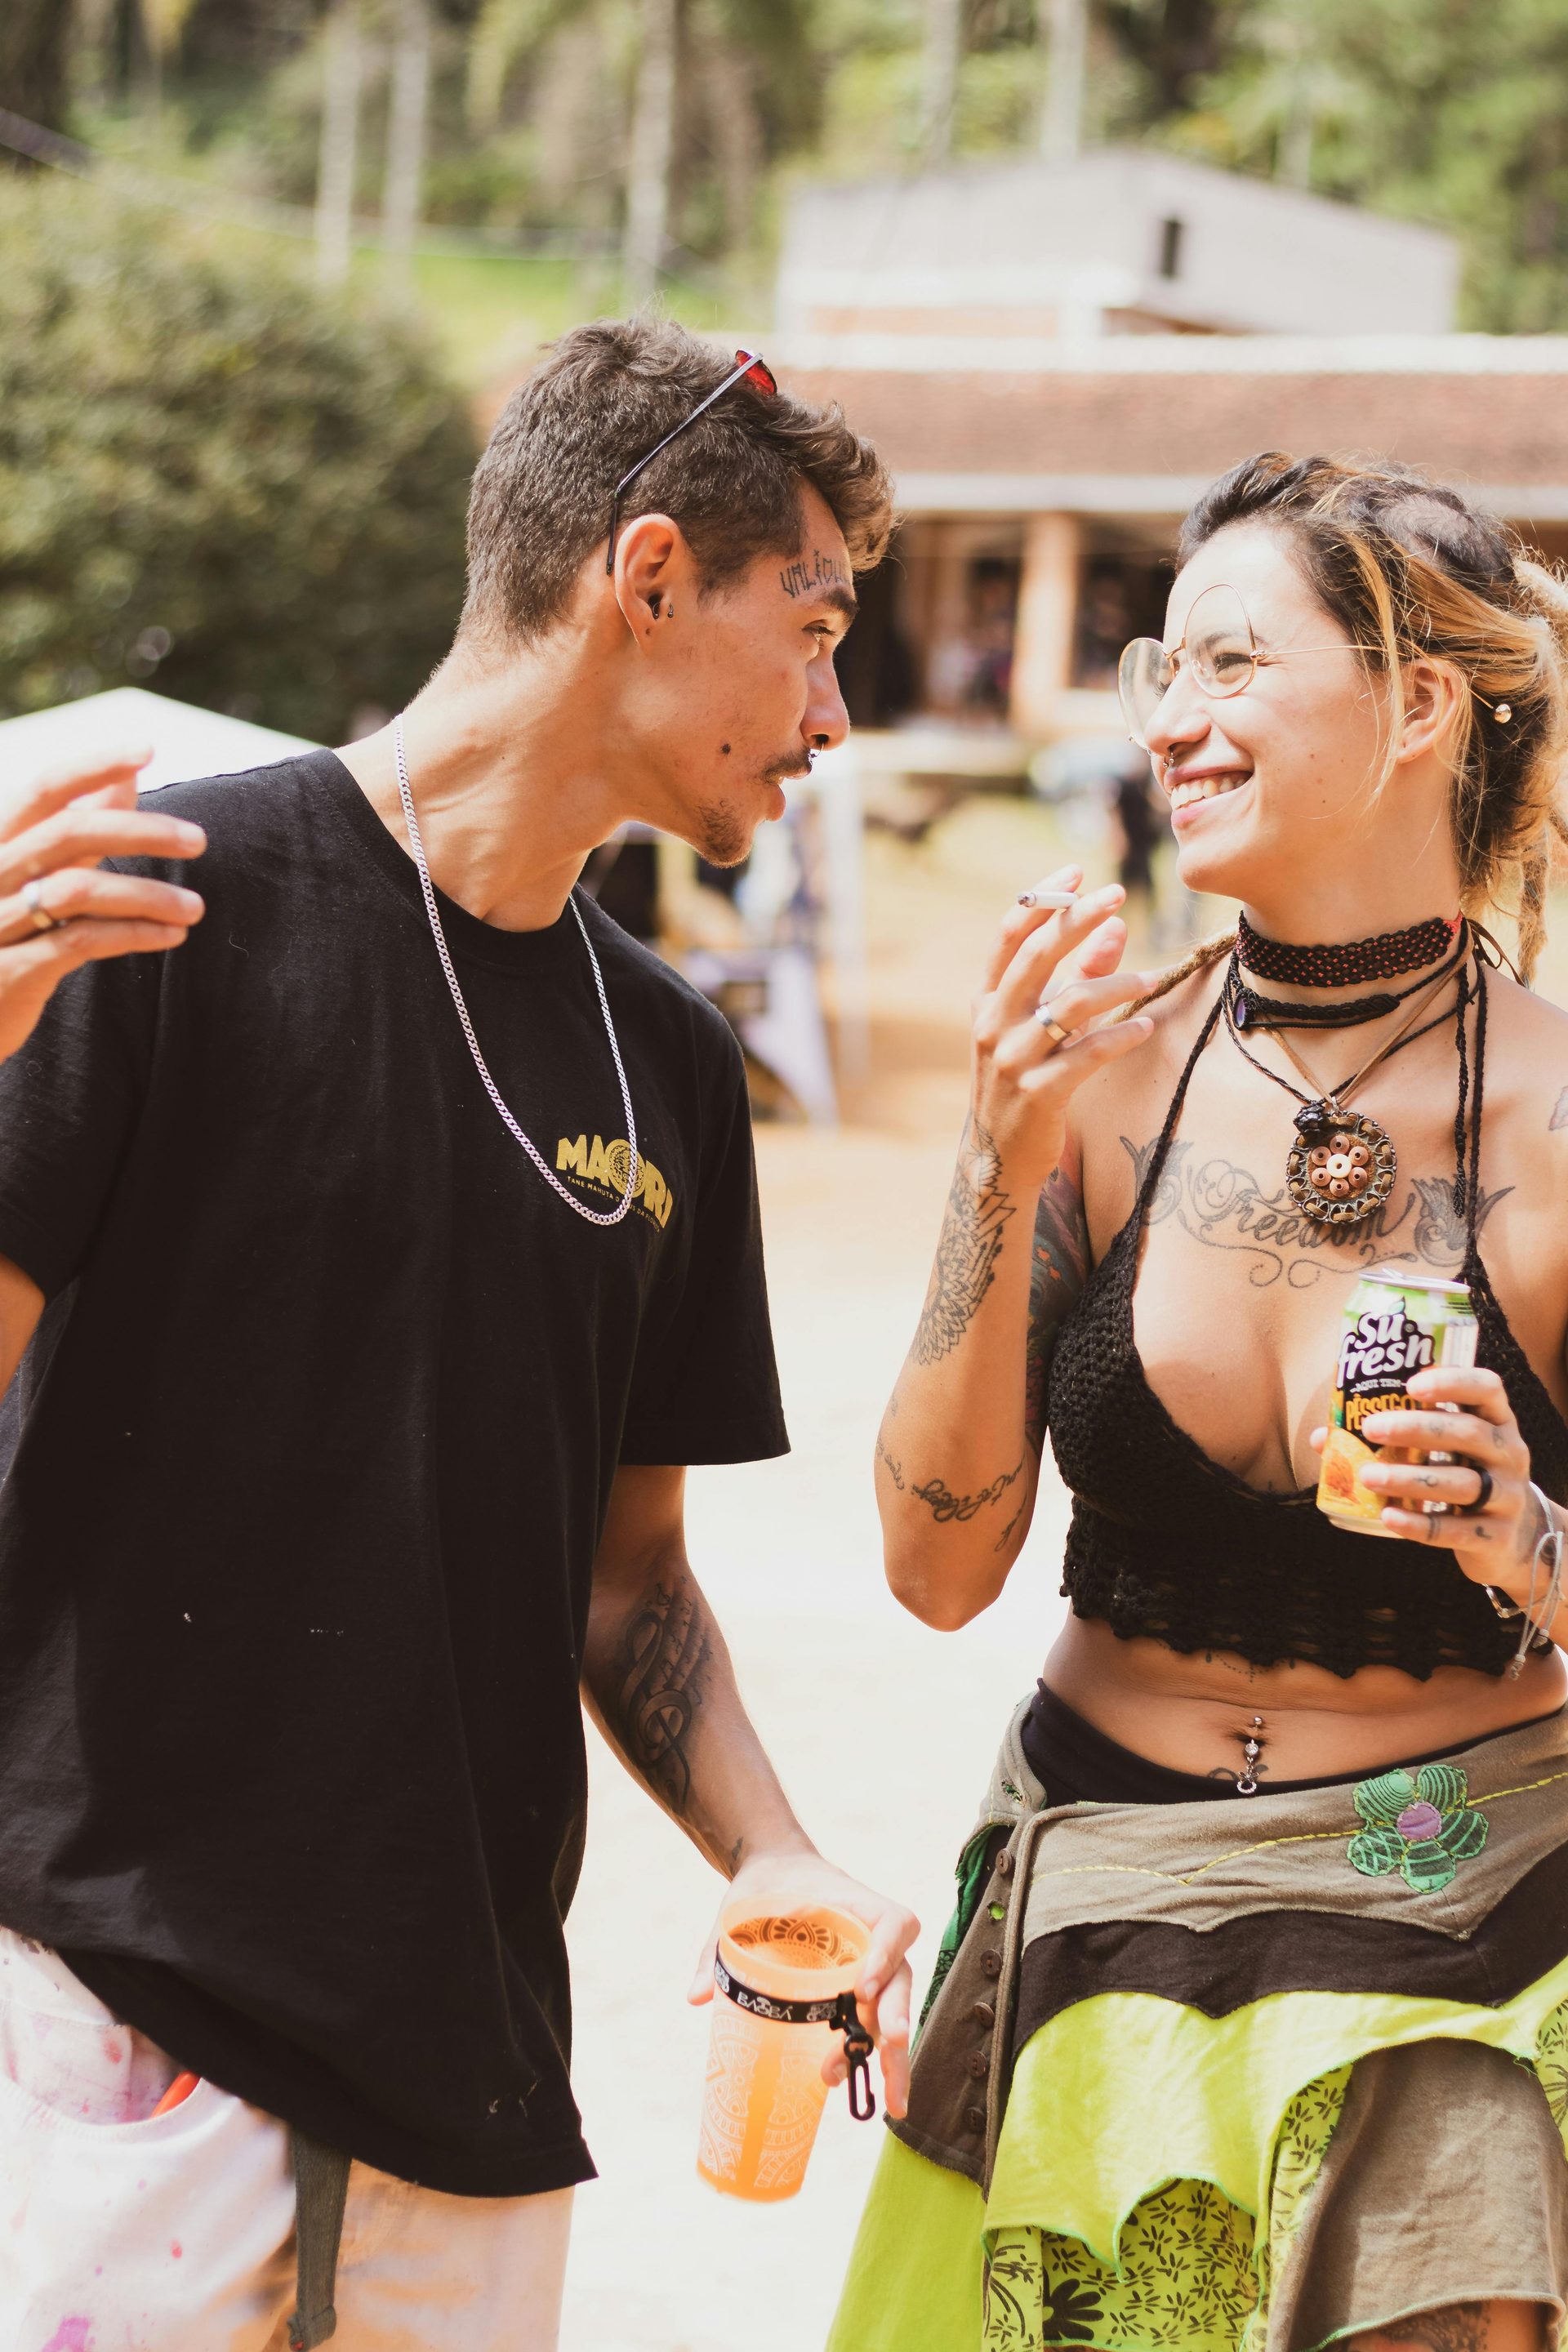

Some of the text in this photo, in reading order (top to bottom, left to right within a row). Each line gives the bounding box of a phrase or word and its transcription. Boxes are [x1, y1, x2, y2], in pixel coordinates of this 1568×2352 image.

[556, 1134, 673, 1228] MAORI
[568, 1176, 586, 1188] TANE
[587, 1183, 613, 1200] MAHUTA
[1336, 1334, 1433, 1388] fresh
